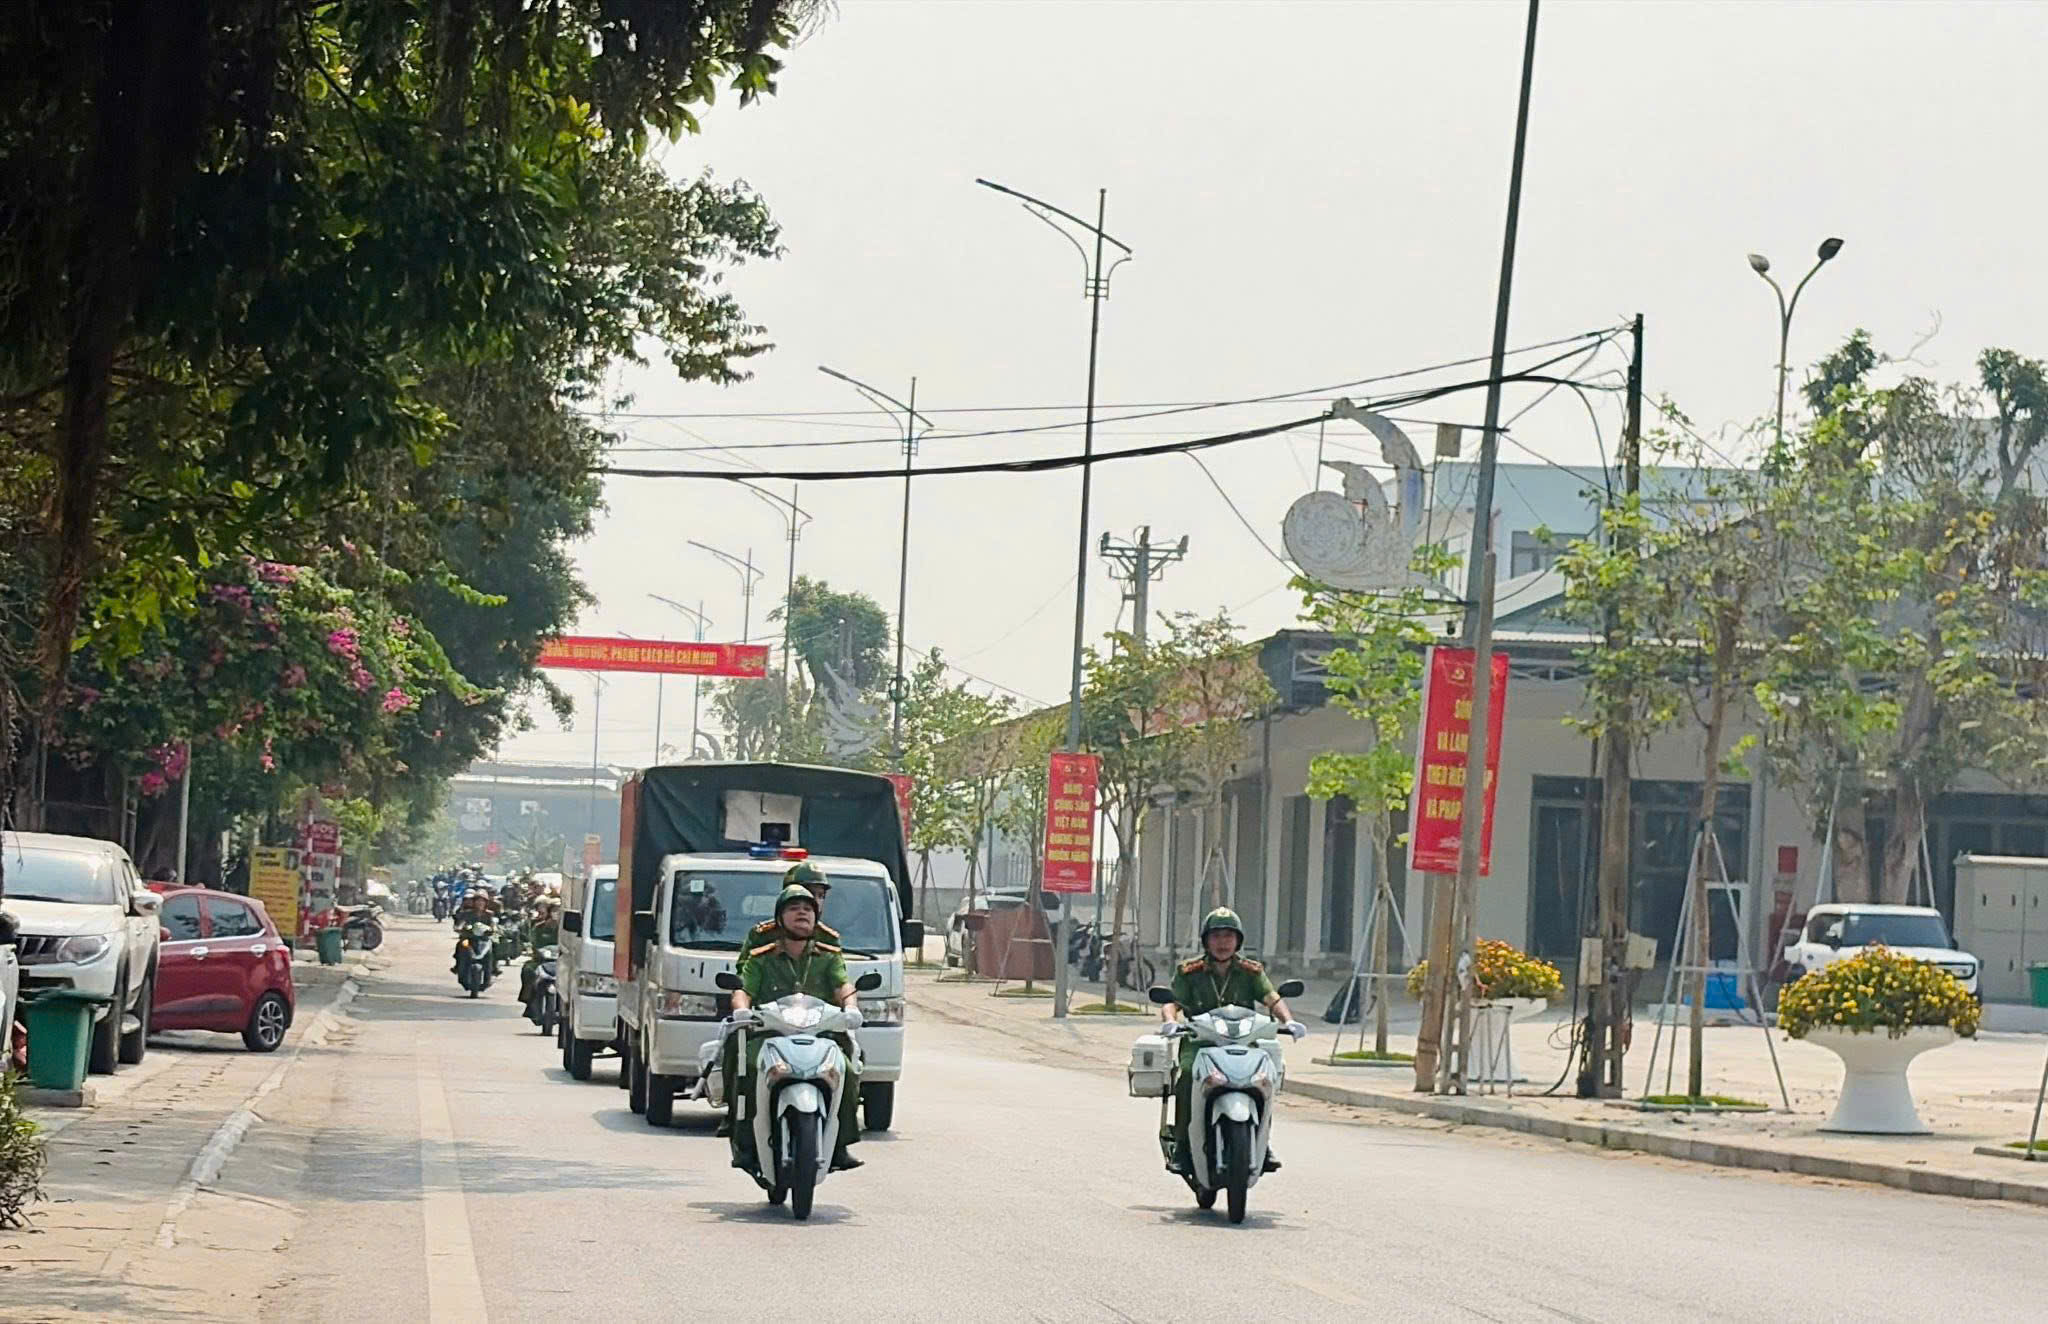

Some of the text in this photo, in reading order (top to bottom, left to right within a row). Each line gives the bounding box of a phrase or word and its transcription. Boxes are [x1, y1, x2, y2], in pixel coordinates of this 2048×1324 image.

[1426, 764, 1448, 785] THEO
[1054, 798, 1089, 811] CỘNG SẢN
[1055, 815, 1088, 829] VIỆT NAM
